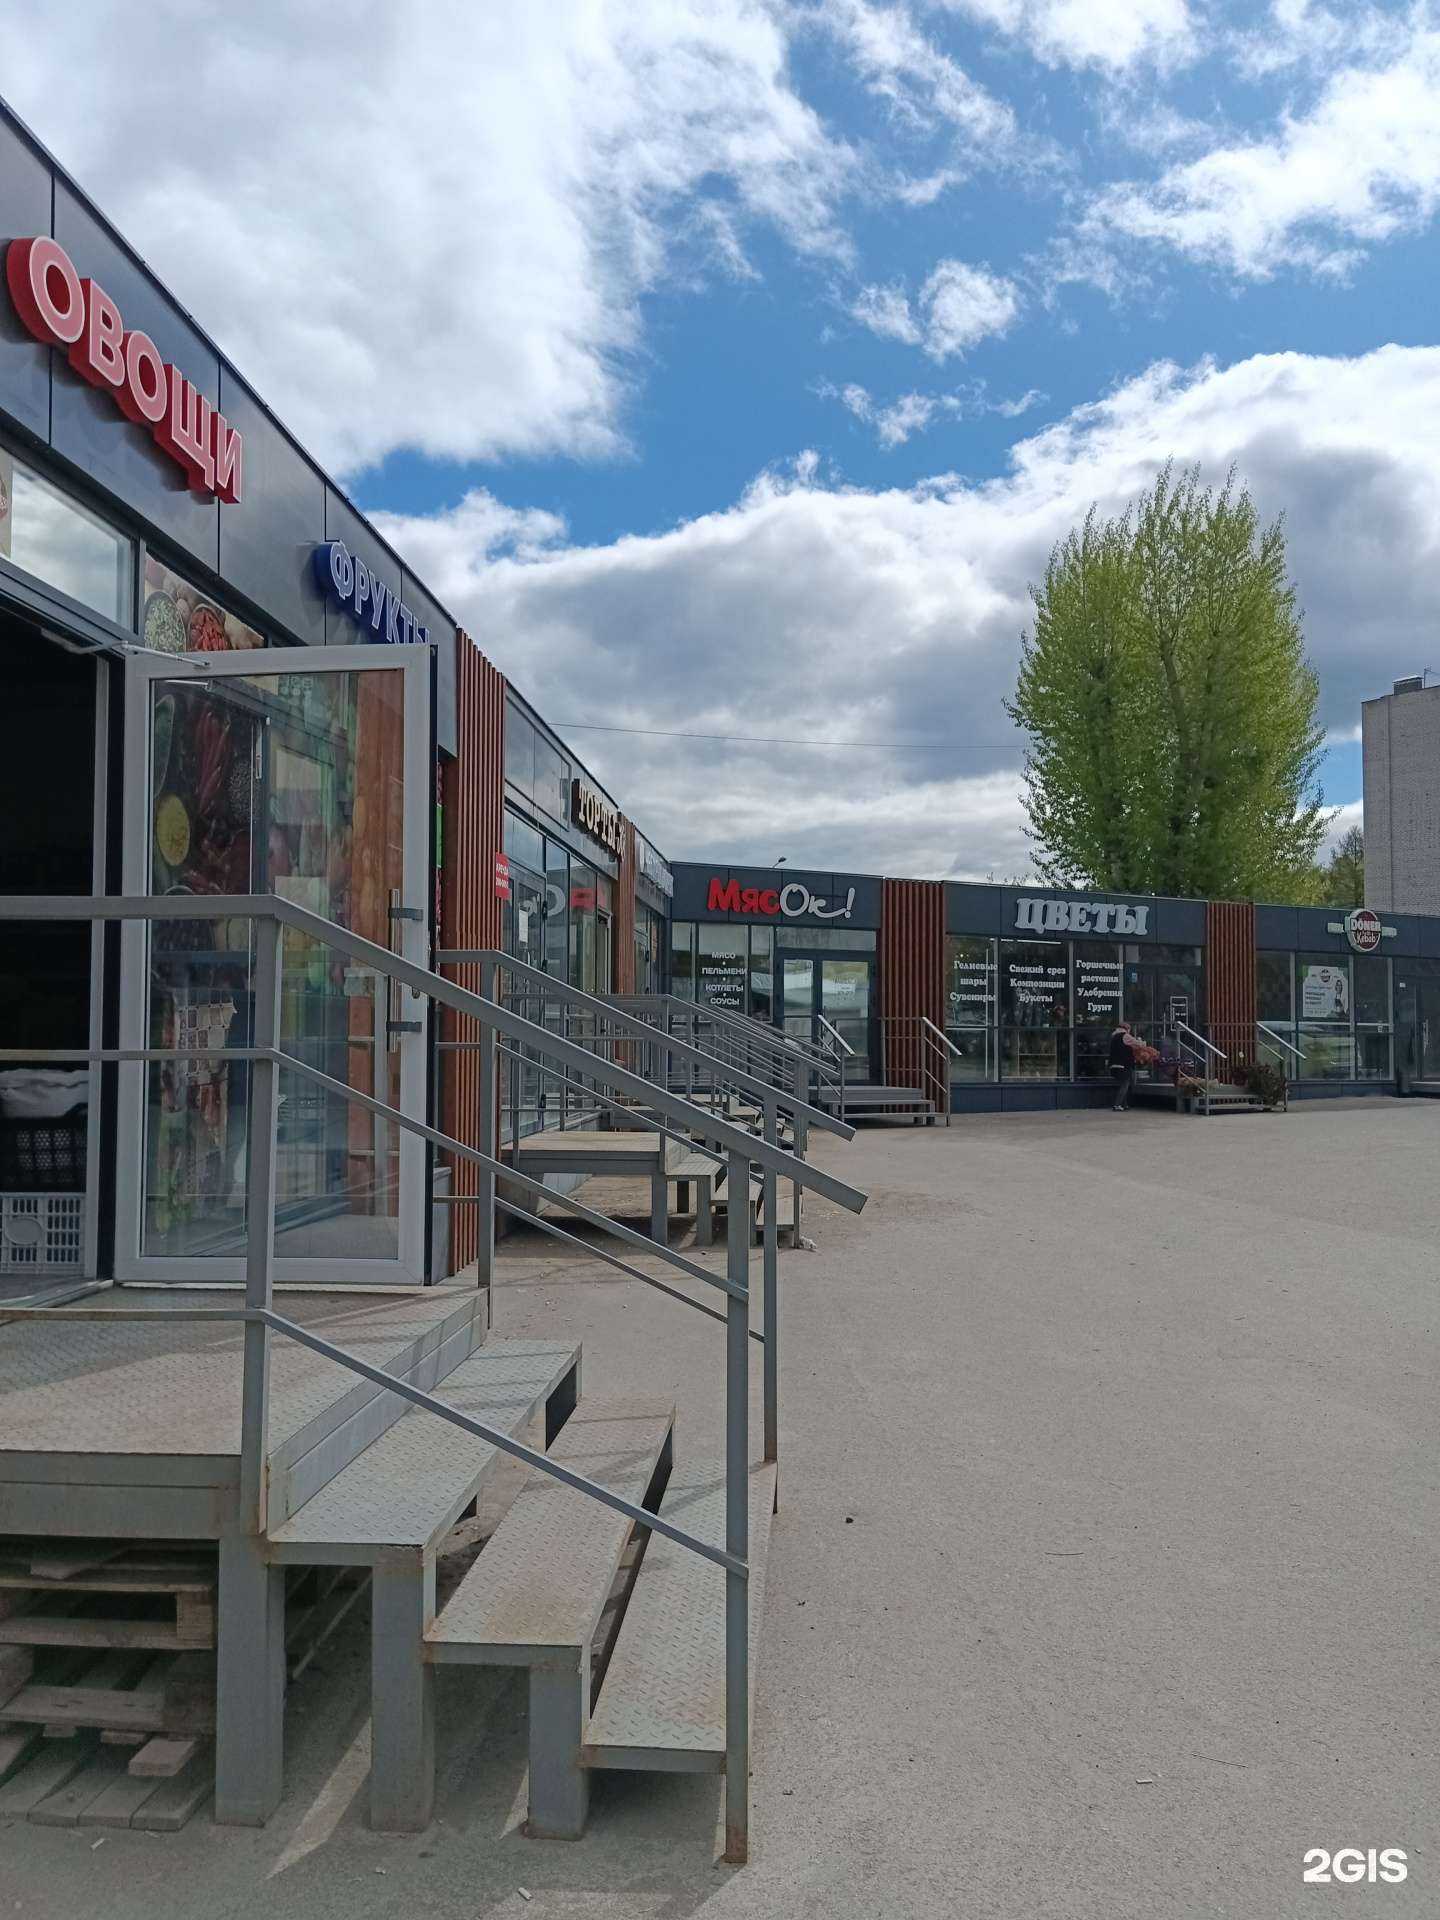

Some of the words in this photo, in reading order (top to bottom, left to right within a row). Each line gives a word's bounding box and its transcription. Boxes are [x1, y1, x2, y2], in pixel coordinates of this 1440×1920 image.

[10, 236, 242, 503] ОВОЩИ
[577, 780, 617, 851] ТОРТЫ
[708, 877, 856, 918] МясОк!
[1014, 898, 1149, 935] ЦВЕТЫ
[711, 951, 736, 959] МЯСО
[953, 960, 998, 971] Гелиевые
[1009, 964, 1044, 974] Свежий
[1047, 966, 1067, 976] срез
[1075, 959, 1123, 970] Горшечные
[701, 967, 748, 975] ПЕЛЬМЕНИ
[960, 978, 988, 987] шары
[1010, 978, 1065, 989] Композиции
[1080, 975, 1119, 984] растения
[705, 983, 744, 992] КОТЛЕТЫ
[1077, 986, 1123, 998] Удобрения
[710, 997, 740, 1006] СОУСЫ
[950, 992, 997, 1002] Сувениры
[1019, 993, 1053, 1003] Букеты
[1087, 1002, 1113, 1013] Грунт
